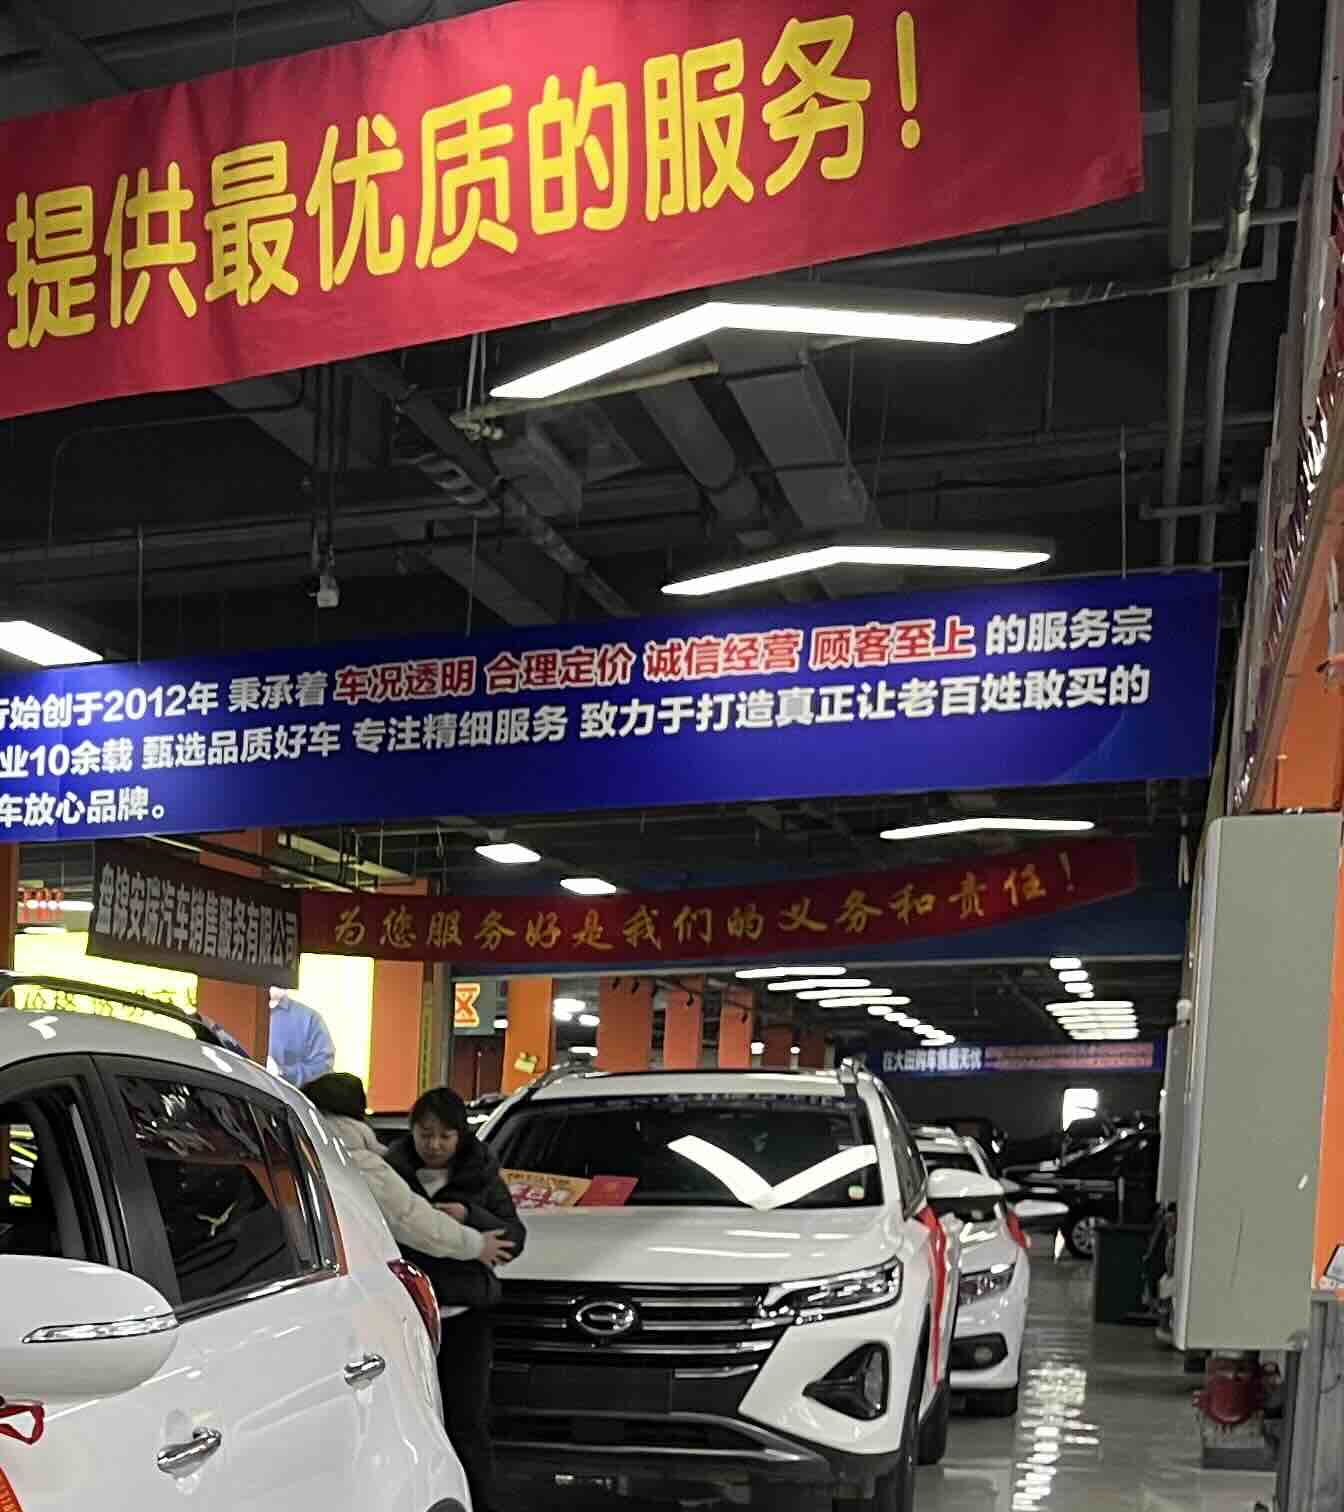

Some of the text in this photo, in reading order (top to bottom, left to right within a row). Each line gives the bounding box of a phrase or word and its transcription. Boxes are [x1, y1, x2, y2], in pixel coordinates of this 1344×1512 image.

[228, 670, 328, 714] 秉承着
[336, 647, 472, 702] 车况透明
[484, 642, 632, 695] 合理定价
[644, 627, 802, 681] 诚信经营
[811, 616, 976, 670] 顾客至上
[985, 606, 1154, 655] 的服务宗
[141, 722, 341, 771] 甄选品质好车
[351, 703, 569, 753] 专注精细服务
[579, 663, 1152, 740] 致力于打造真正让老百姓敢买的
